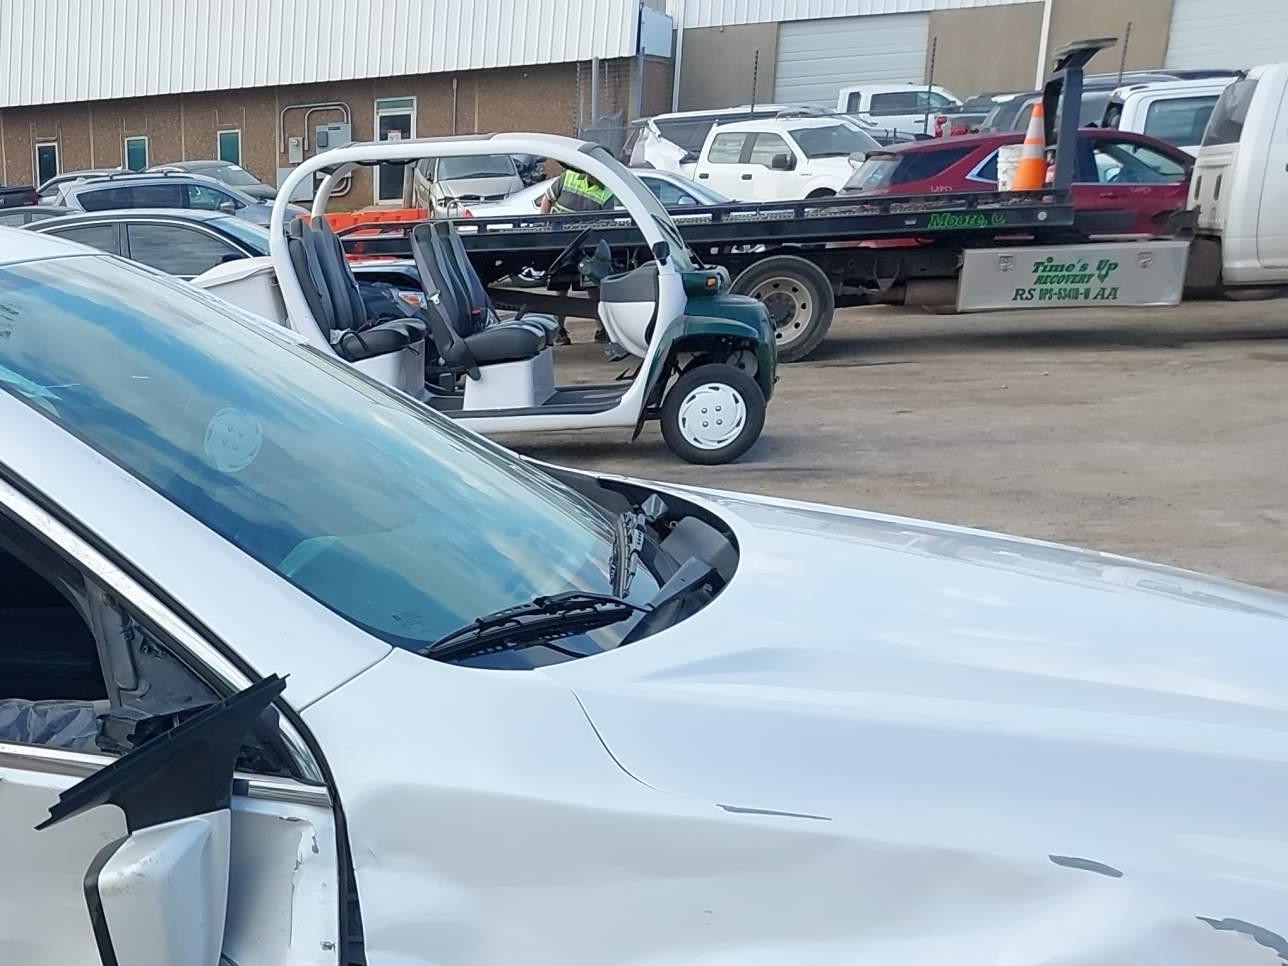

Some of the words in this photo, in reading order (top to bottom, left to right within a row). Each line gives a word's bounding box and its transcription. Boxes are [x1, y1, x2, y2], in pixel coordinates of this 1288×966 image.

[1032, 257, 1090, 273] Time's
[1096, 259, 1118, 284] Up
[1033, 274, 1095, 285] RECOVERY
[1012, 288, 1037, 301] RS
[1092, 287, 1120, 300] AA
